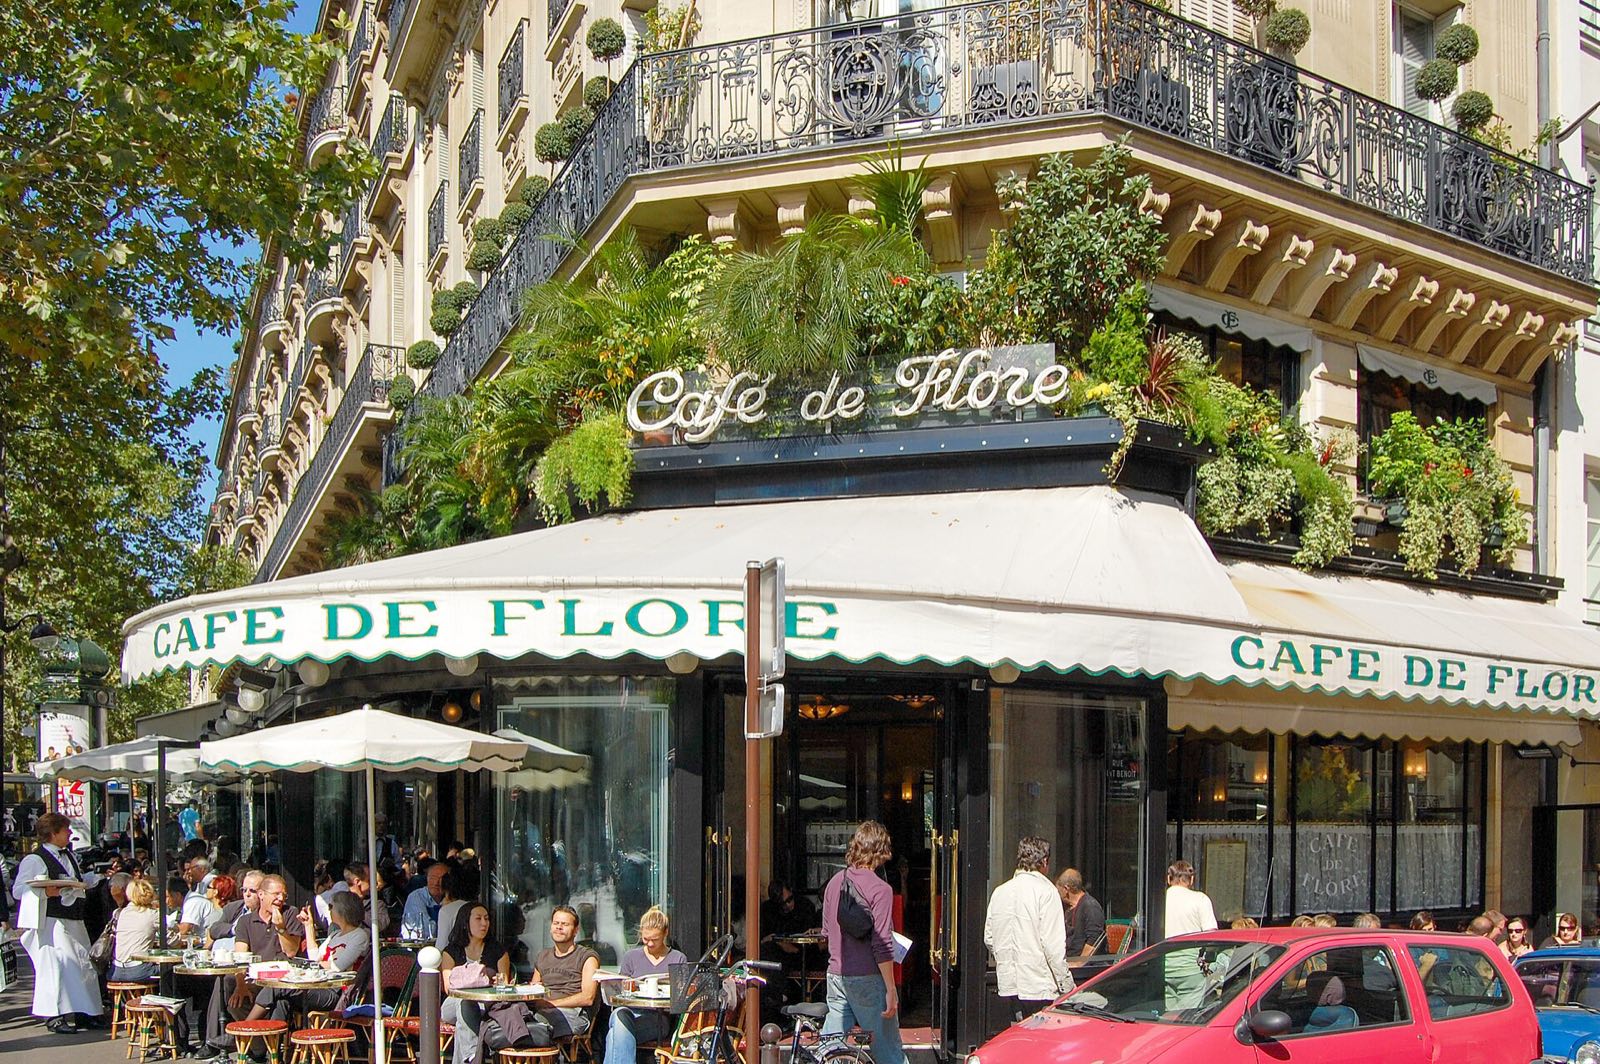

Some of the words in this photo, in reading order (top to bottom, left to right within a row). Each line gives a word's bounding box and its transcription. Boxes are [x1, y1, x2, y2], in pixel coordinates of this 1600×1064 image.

[626, 369, 771, 442] Café
[800, 370, 866, 422] de
[892, 348, 1070, 418] Flore
[153, 607, 285, 659] CAFE
[322, 601, 438, 641] DE
[488, 598, 840, 640] FLORE
[1231, 635, 1381, 682] CAFE
[1405, 655, 1466, 692] DE
[1310, 833, 1358, 853] CAFE
[1302, 870, 1367, 897] FLORE
